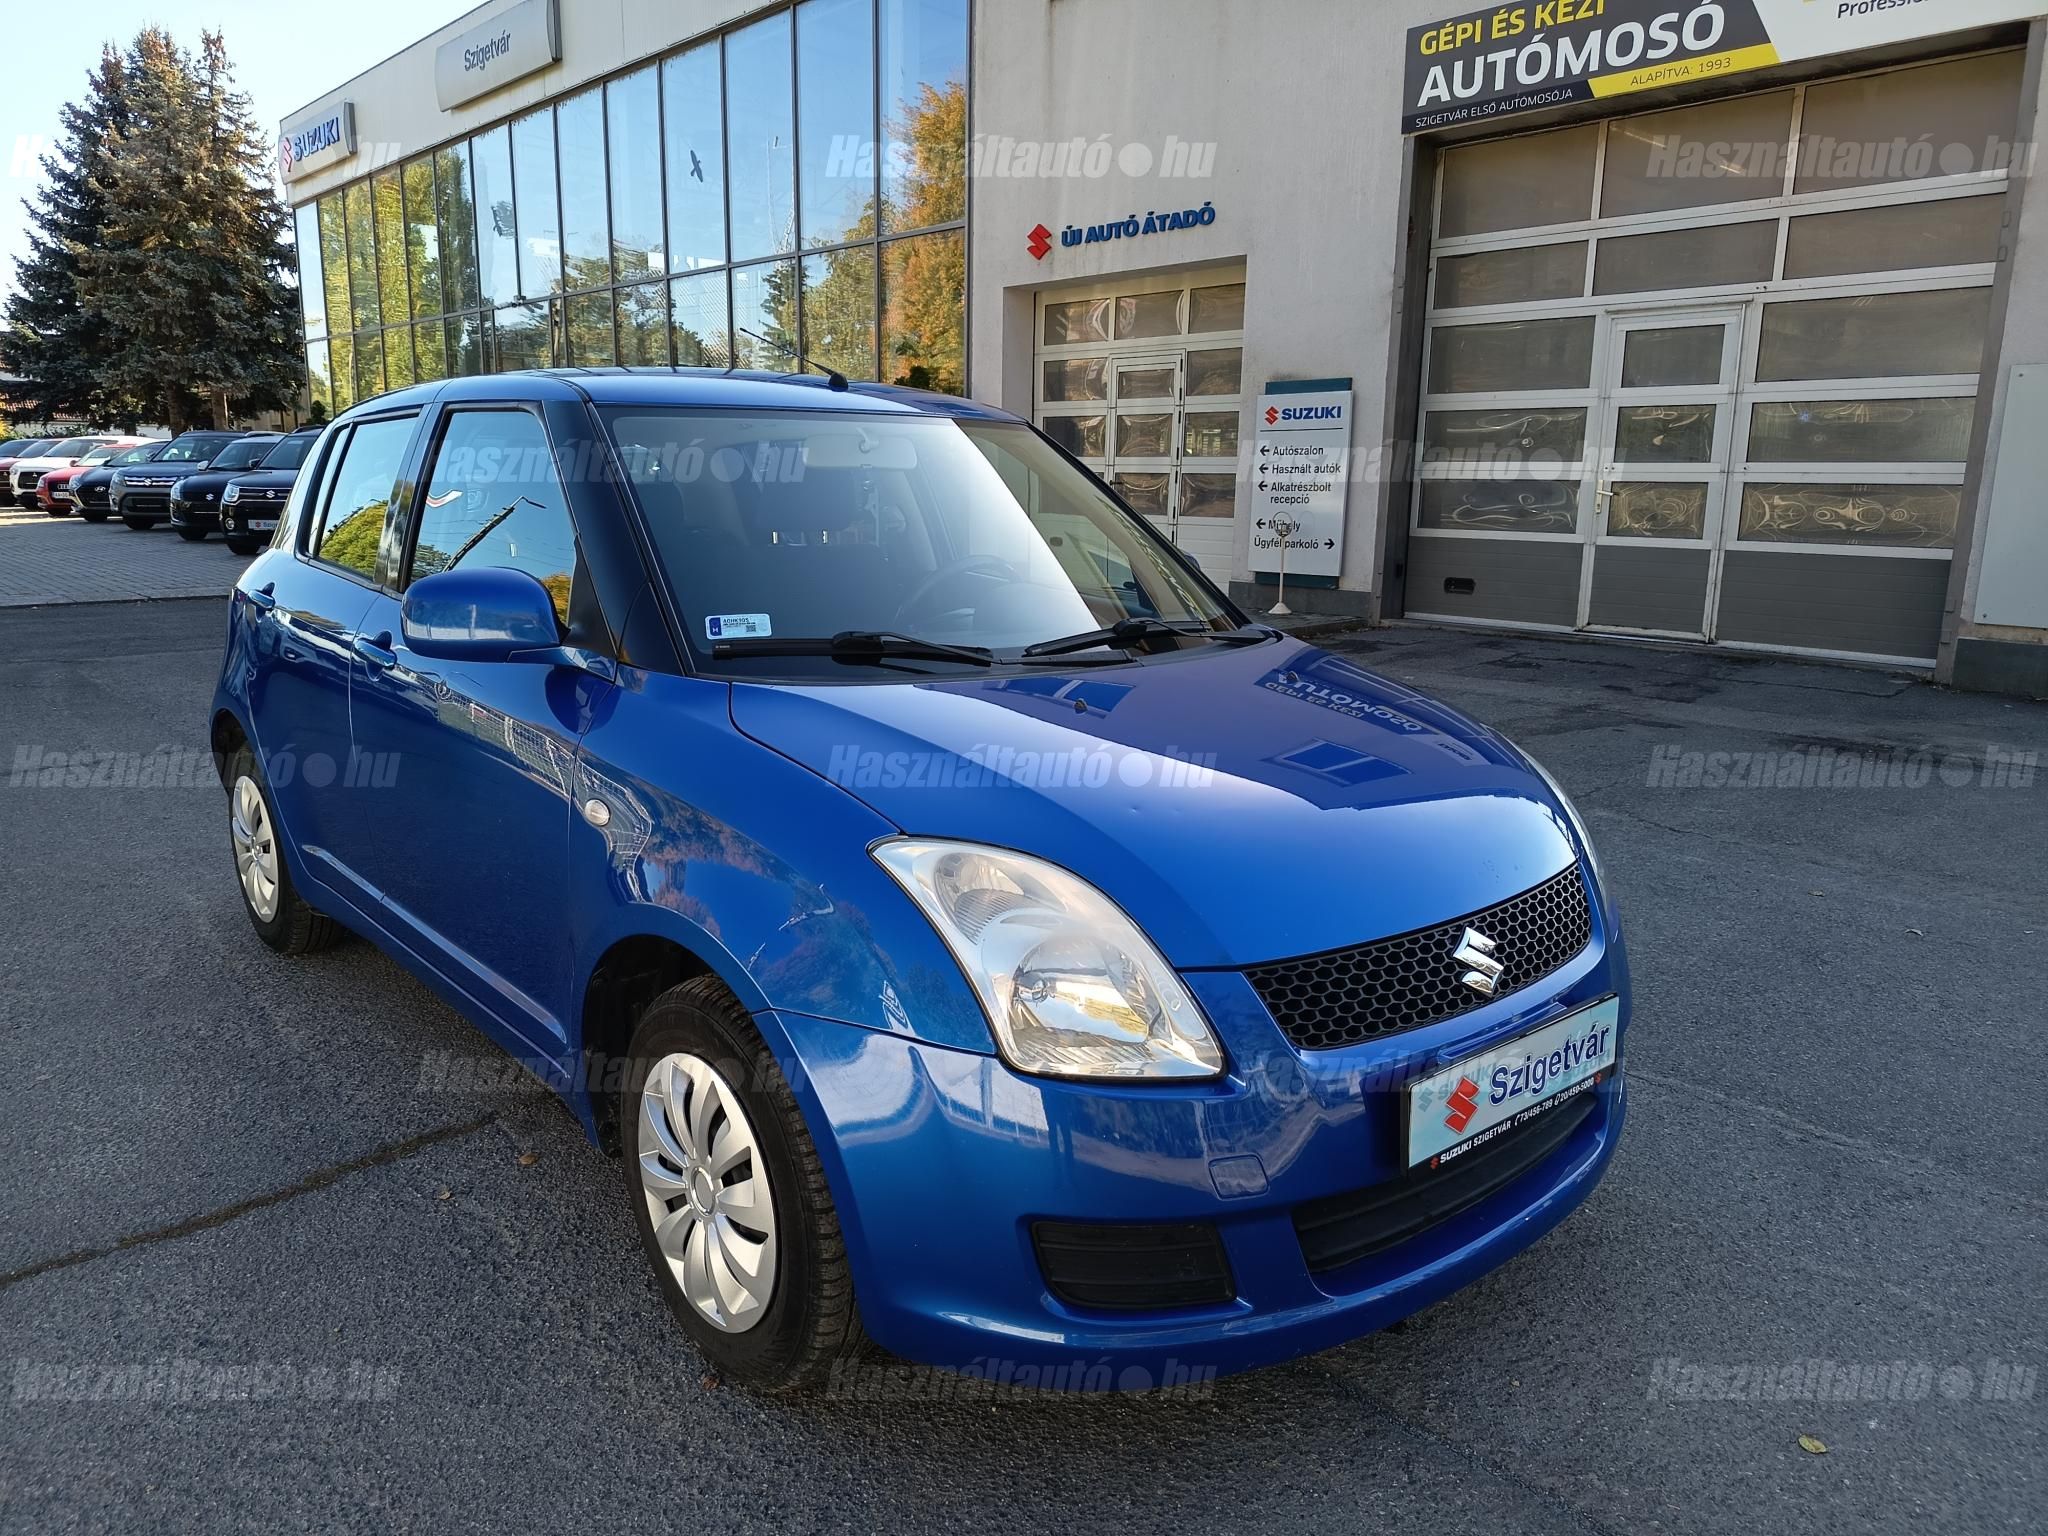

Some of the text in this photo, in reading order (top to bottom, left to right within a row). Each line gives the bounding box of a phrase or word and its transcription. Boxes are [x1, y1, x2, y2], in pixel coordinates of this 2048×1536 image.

[464, 28, 511, 72] Szigetvár
[1420, 17, 1482, 56] GÉPI
[1491, 7, 1526, 40] ÉS
[1417, 0, 1725, 107] AUTÓMOSÓ
[1630, 57, 1732, 86] ALAPÍTVA: 1993
[1415, 88, 1573, 129] SZIGETVÁR ELSŐ AUTÓMOSÓJA
[293, 116, 340, 162] SUZUKI
[1060, 201, 1216, 248] ÚJ AUTÓ ÁTADÓ
[1281, 405, 1342, 421] SUZUKI
[1271, 462, 1341, 475] Használt autók
[1272, 445, 1324, 457] Autószalon
[1270, 481, 1332, 493] Alkatrészbolt
[1270, 494, 1310, 506] recepció
[1284, 537, 1319, 550] parkoló
[1489, 1020, 1610, 1105] Szigetvár
[1439, 1141, 1472, 1164] SUZUKI
[1473, 1120, 1512, 1147] SZIGETVÁR
